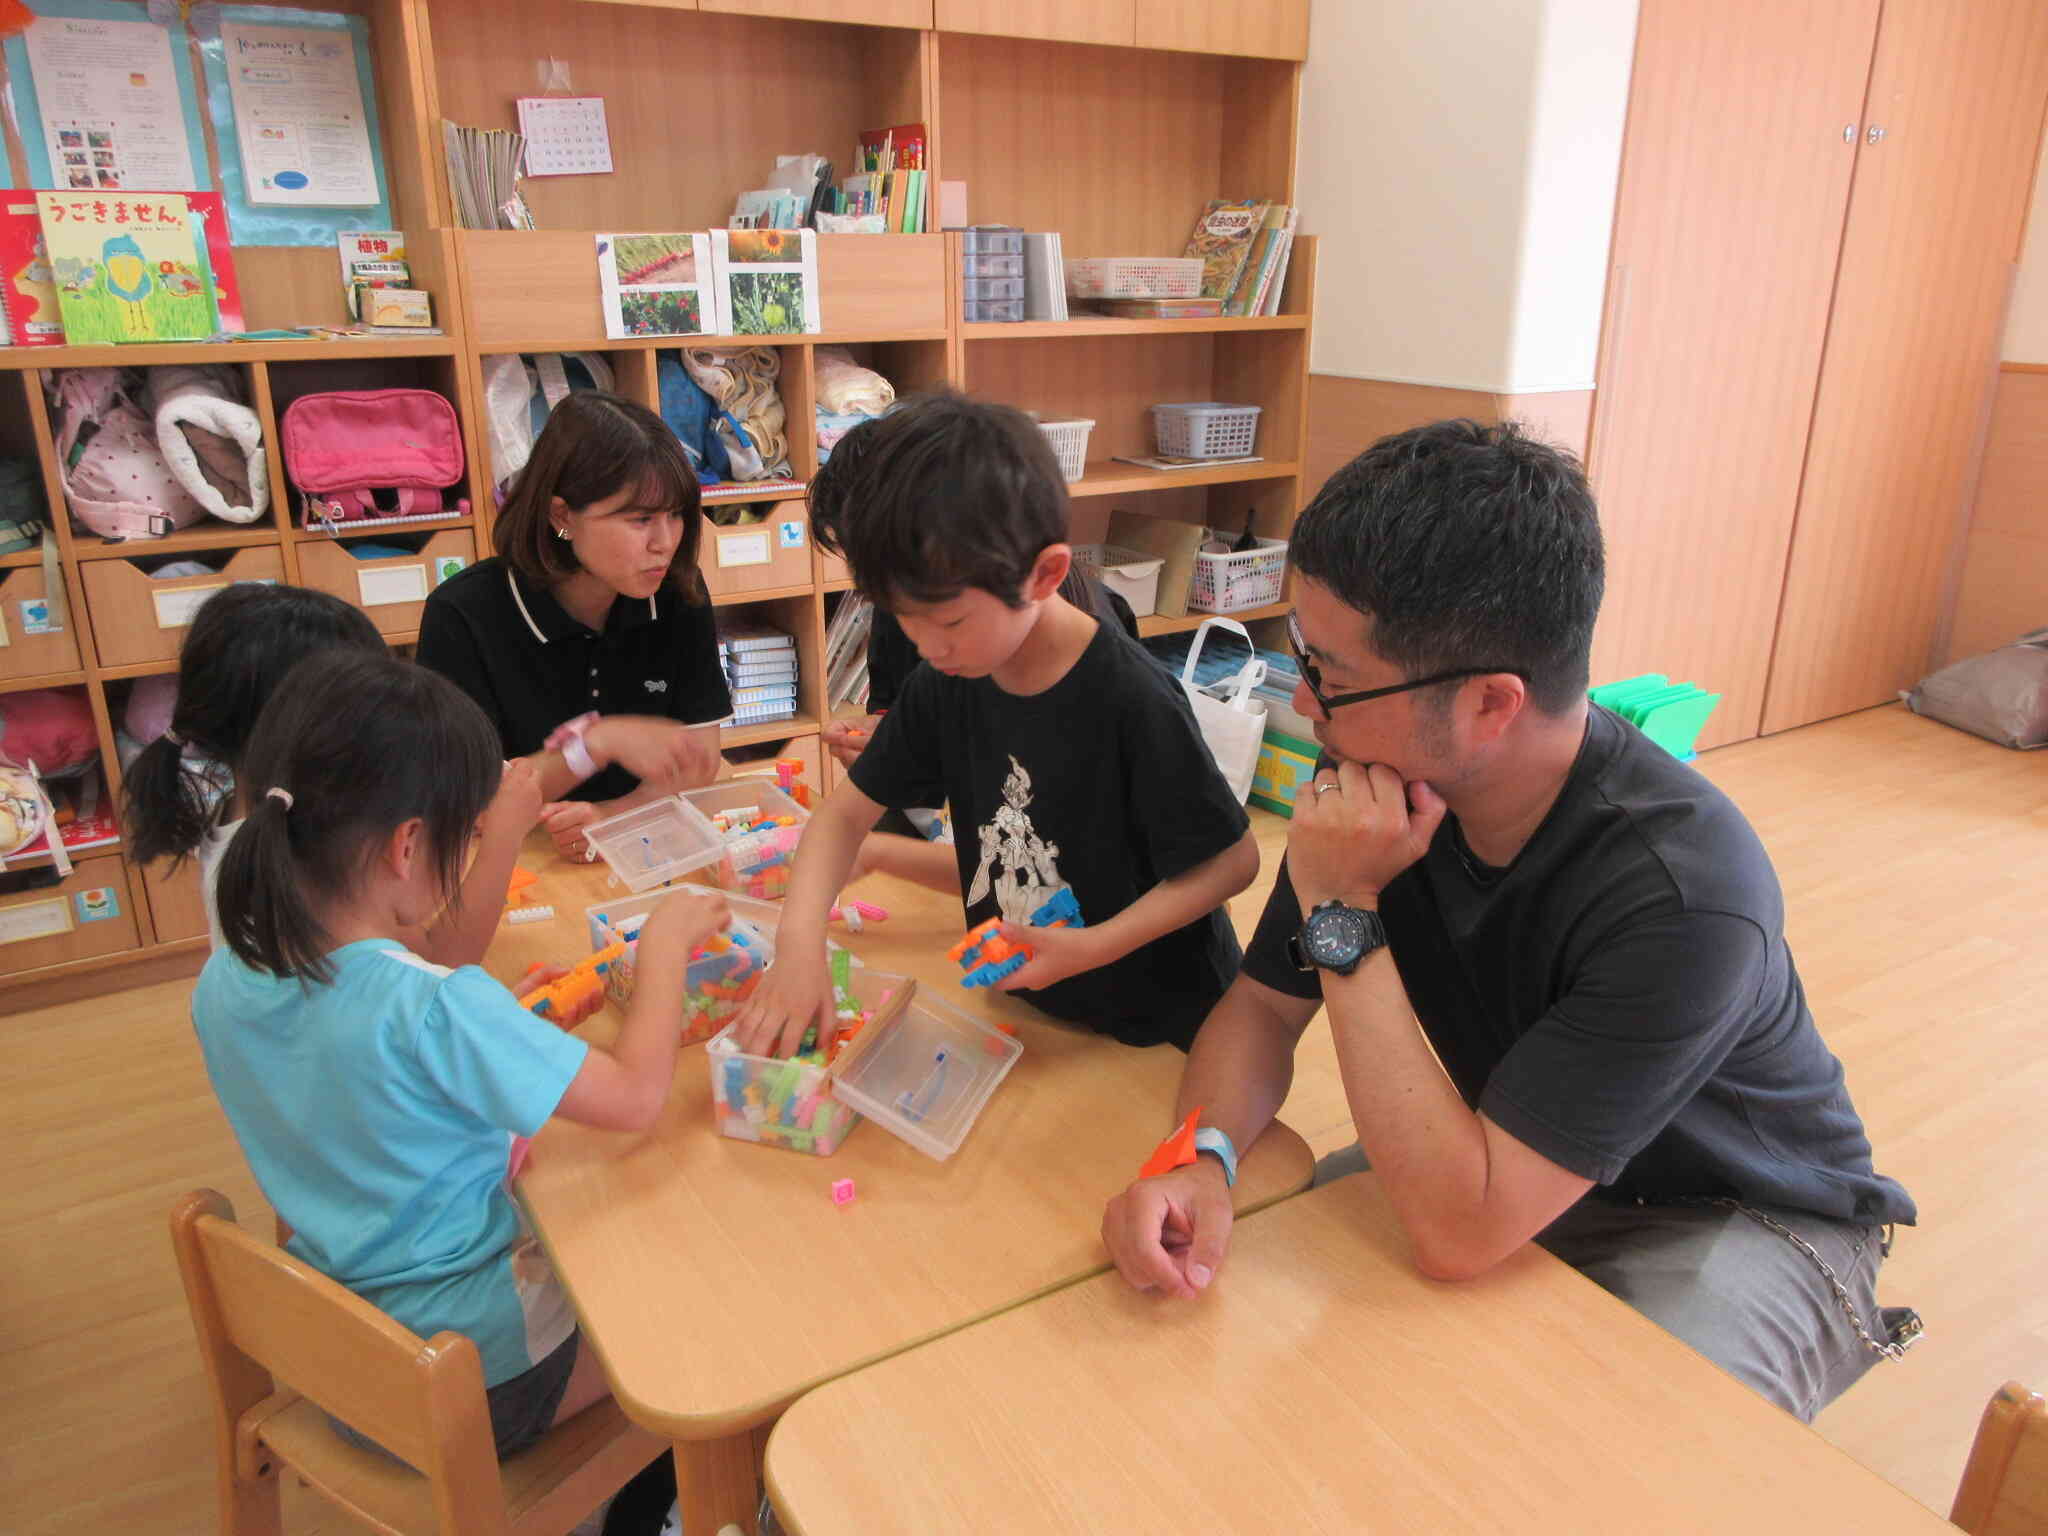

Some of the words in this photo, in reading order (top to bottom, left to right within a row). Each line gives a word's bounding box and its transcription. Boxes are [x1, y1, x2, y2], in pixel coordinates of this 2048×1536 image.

[49, 197, 183, 227] うごきません。
[357, 239, 388, 253] 植物
